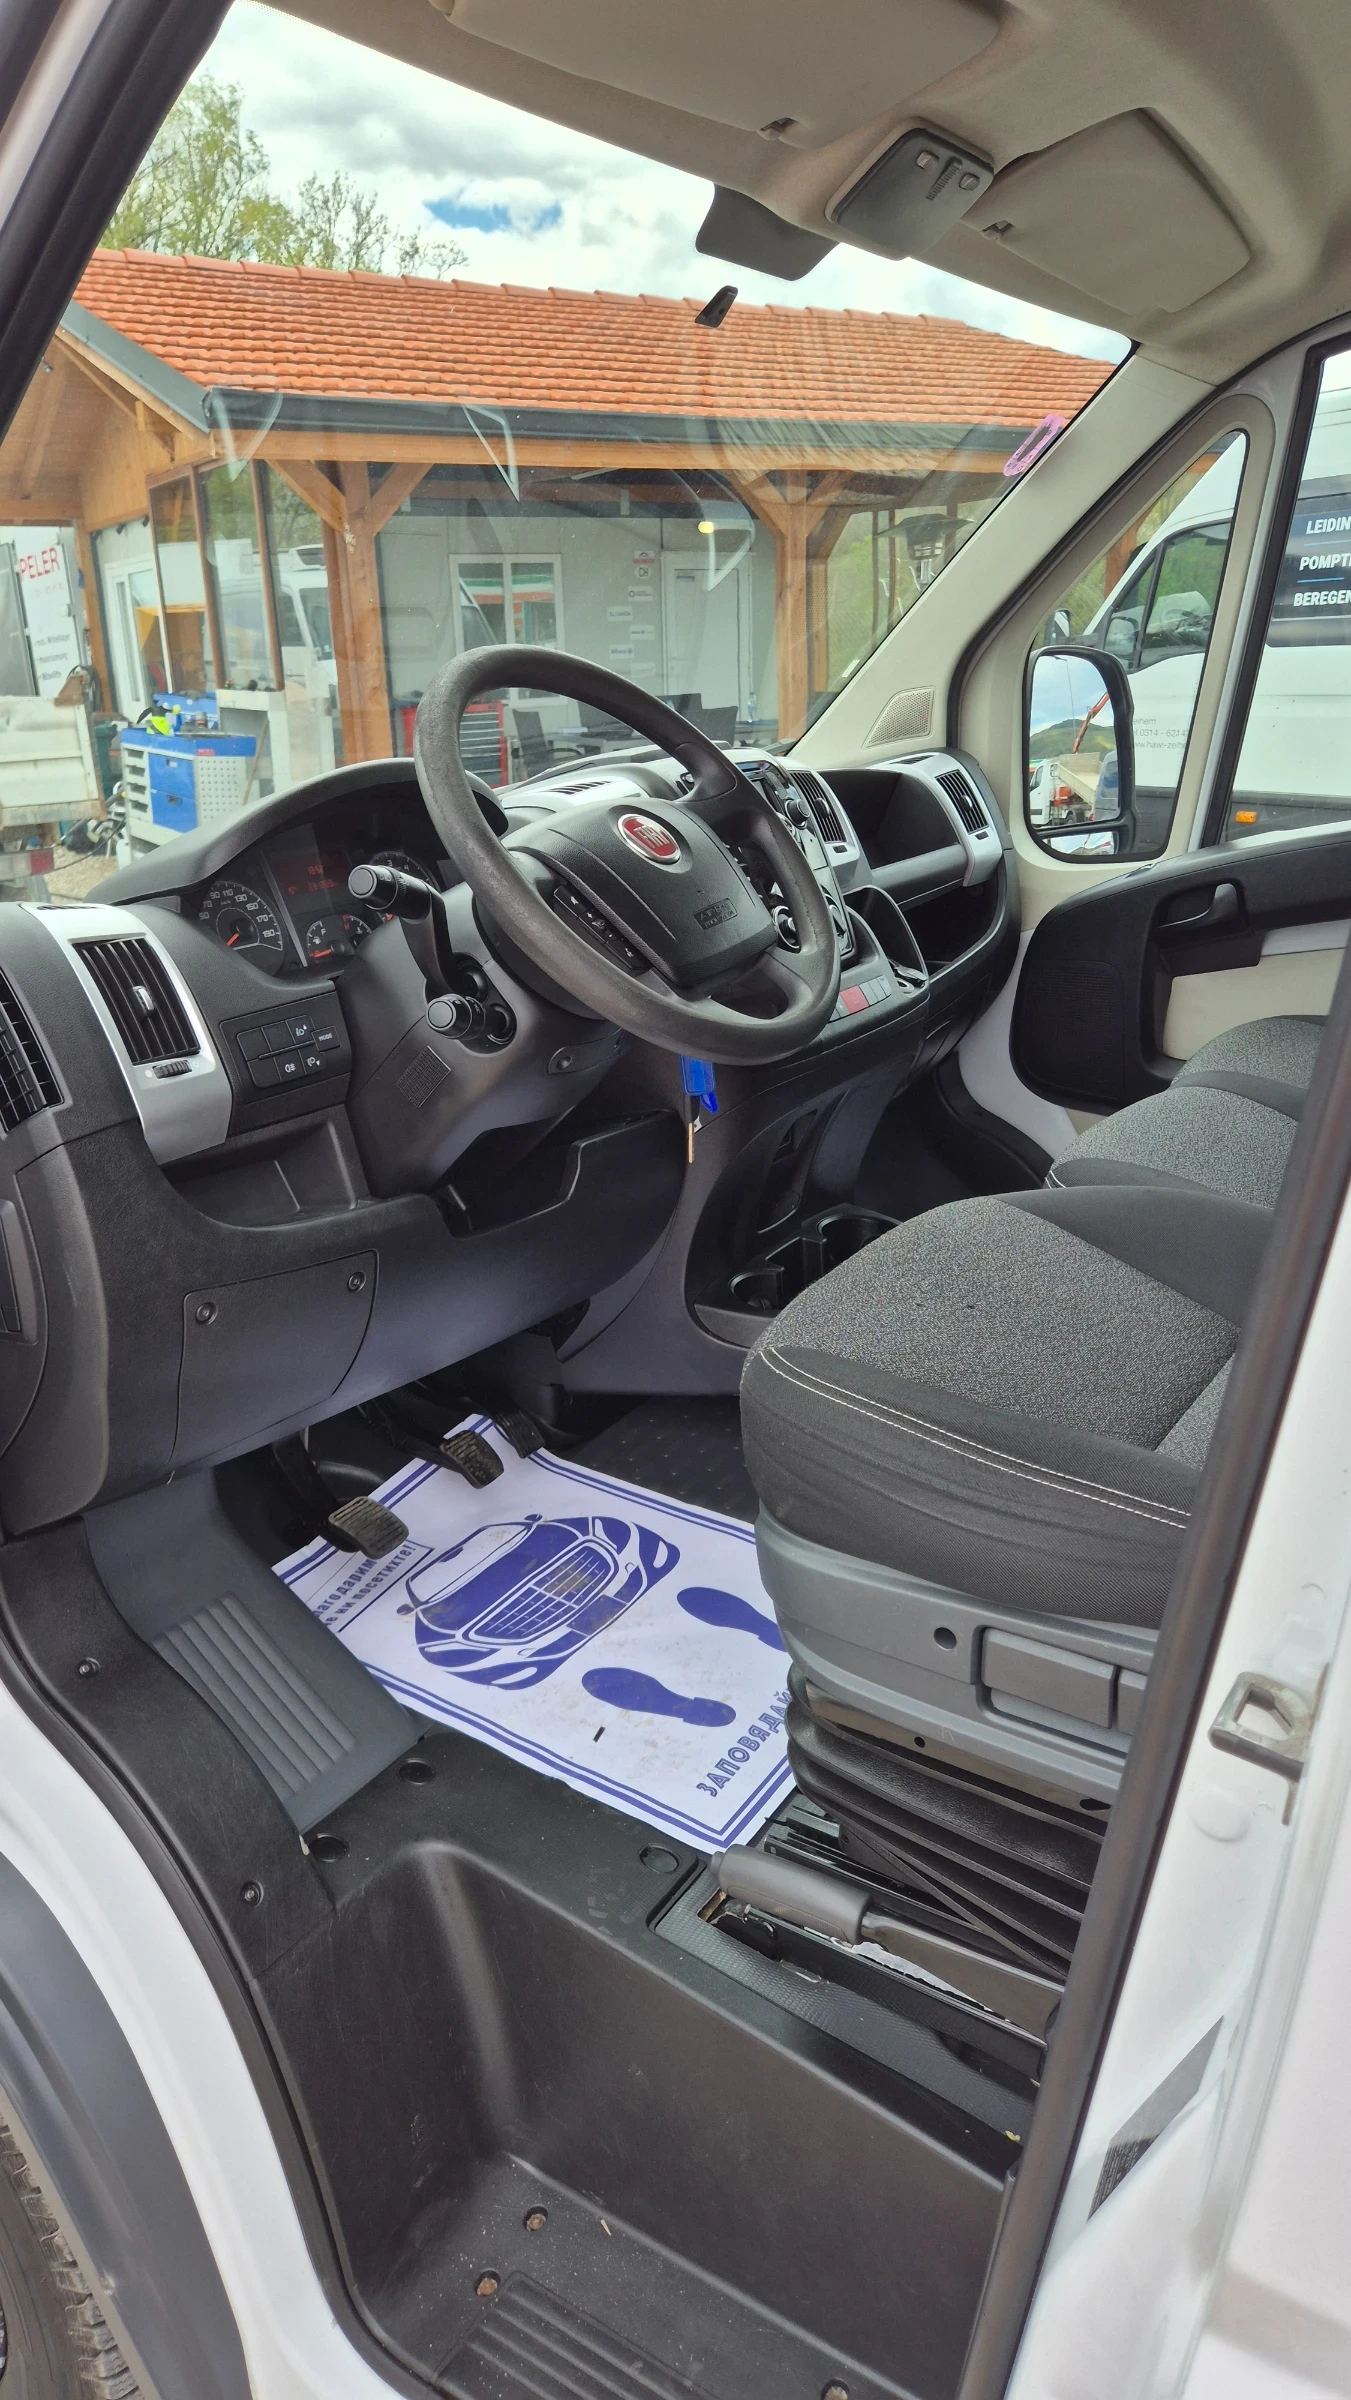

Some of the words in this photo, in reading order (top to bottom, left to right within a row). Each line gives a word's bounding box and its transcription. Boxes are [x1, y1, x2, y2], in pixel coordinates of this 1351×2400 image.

[1305, 516, 1351, 534] LEIDIN
[18, 547, 60, 581] PELER
[1299, 553, 1351, 571] POMPT
[1133, 717, 1157, 725] elhem
[633, 825, 670, 849] FIAT
[210, 891, 220, 900] 90
[222, 888, 234, 897] 110
[234, 894, 248, 902] 130
[203, 900, 213, 908] 70
[246, 902, 259, 911] 150
[256, 914, 269, 922] 170
[335, 1601, 357, 1614] ни
[352, 1544, 417, 1600] посетихте!
[312, 1558, 378, 1618] лагодарим
[696, 1688, 792, 1798] ЗАПОВЯДАЙ
